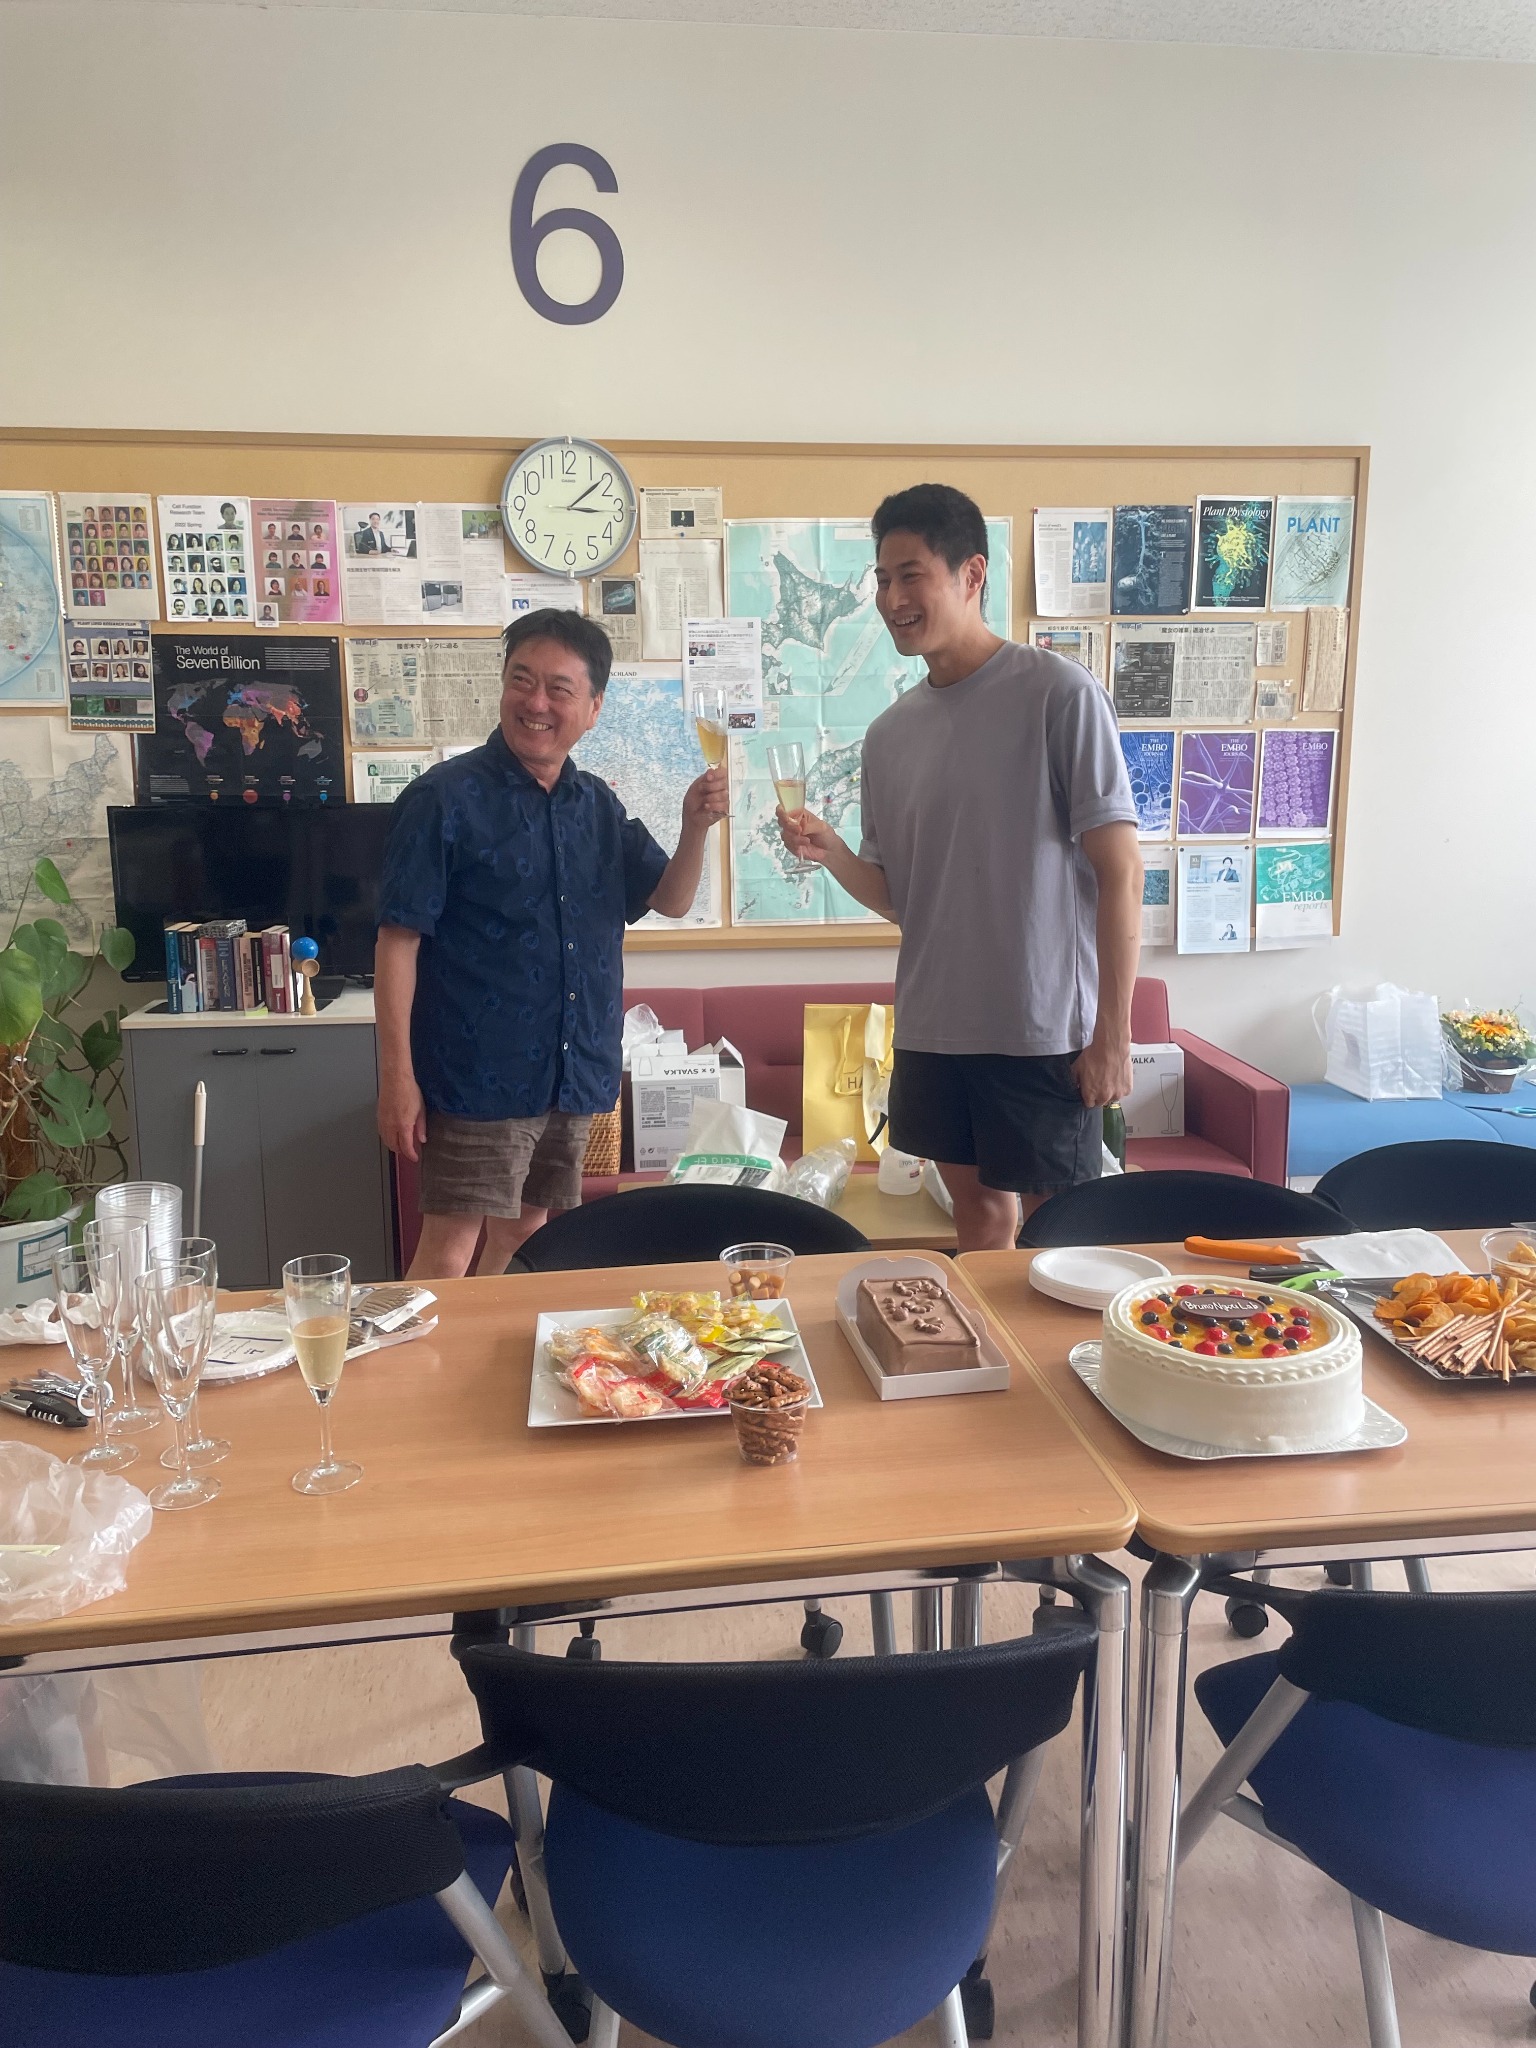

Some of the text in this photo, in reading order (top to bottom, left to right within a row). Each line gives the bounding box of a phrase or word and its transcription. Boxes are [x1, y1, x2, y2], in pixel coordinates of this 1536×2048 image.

[510, 142, 624, 325] 6
[541, 454, 553, 479] 11
[561, 450, 576, 475] 12
[589, 455, 593, 481] 1
[523, 470, 540, 495] 10
[601, 472, 613, 497] 2
[513, 495, 526, 520] 9
[613, 498, 624, 522] 3
[1203, 506, 1271, 519] Plant Physiology
[525, 519, 536, 544] 8
[601, 521, 612, 546] 4
[1287, 517, 1340, 533] PLANT
[543, 534, 555, 559] 7
[563, 541, 576, 565] 6
[586, 535, 599, 560] 5
[174, 646, 228, 655] The World of
[176, 655, 218, 669] Seven
[221, 655, 260, 670] Billion
[1141, 743, 1168, 751] EMBO
[1221, 743, 1248, 751] EMBO
[1302, 742, 1328, 750] EMBO
[1282, 890, 1325, 903] EMBO
[1294, 901, 1328, 912] reports
[694, 1157, 707, 1165] EF
[1184, 1300, 1213, 1310] Bruno
[1237, 1302, 1259, 1310] Lab
